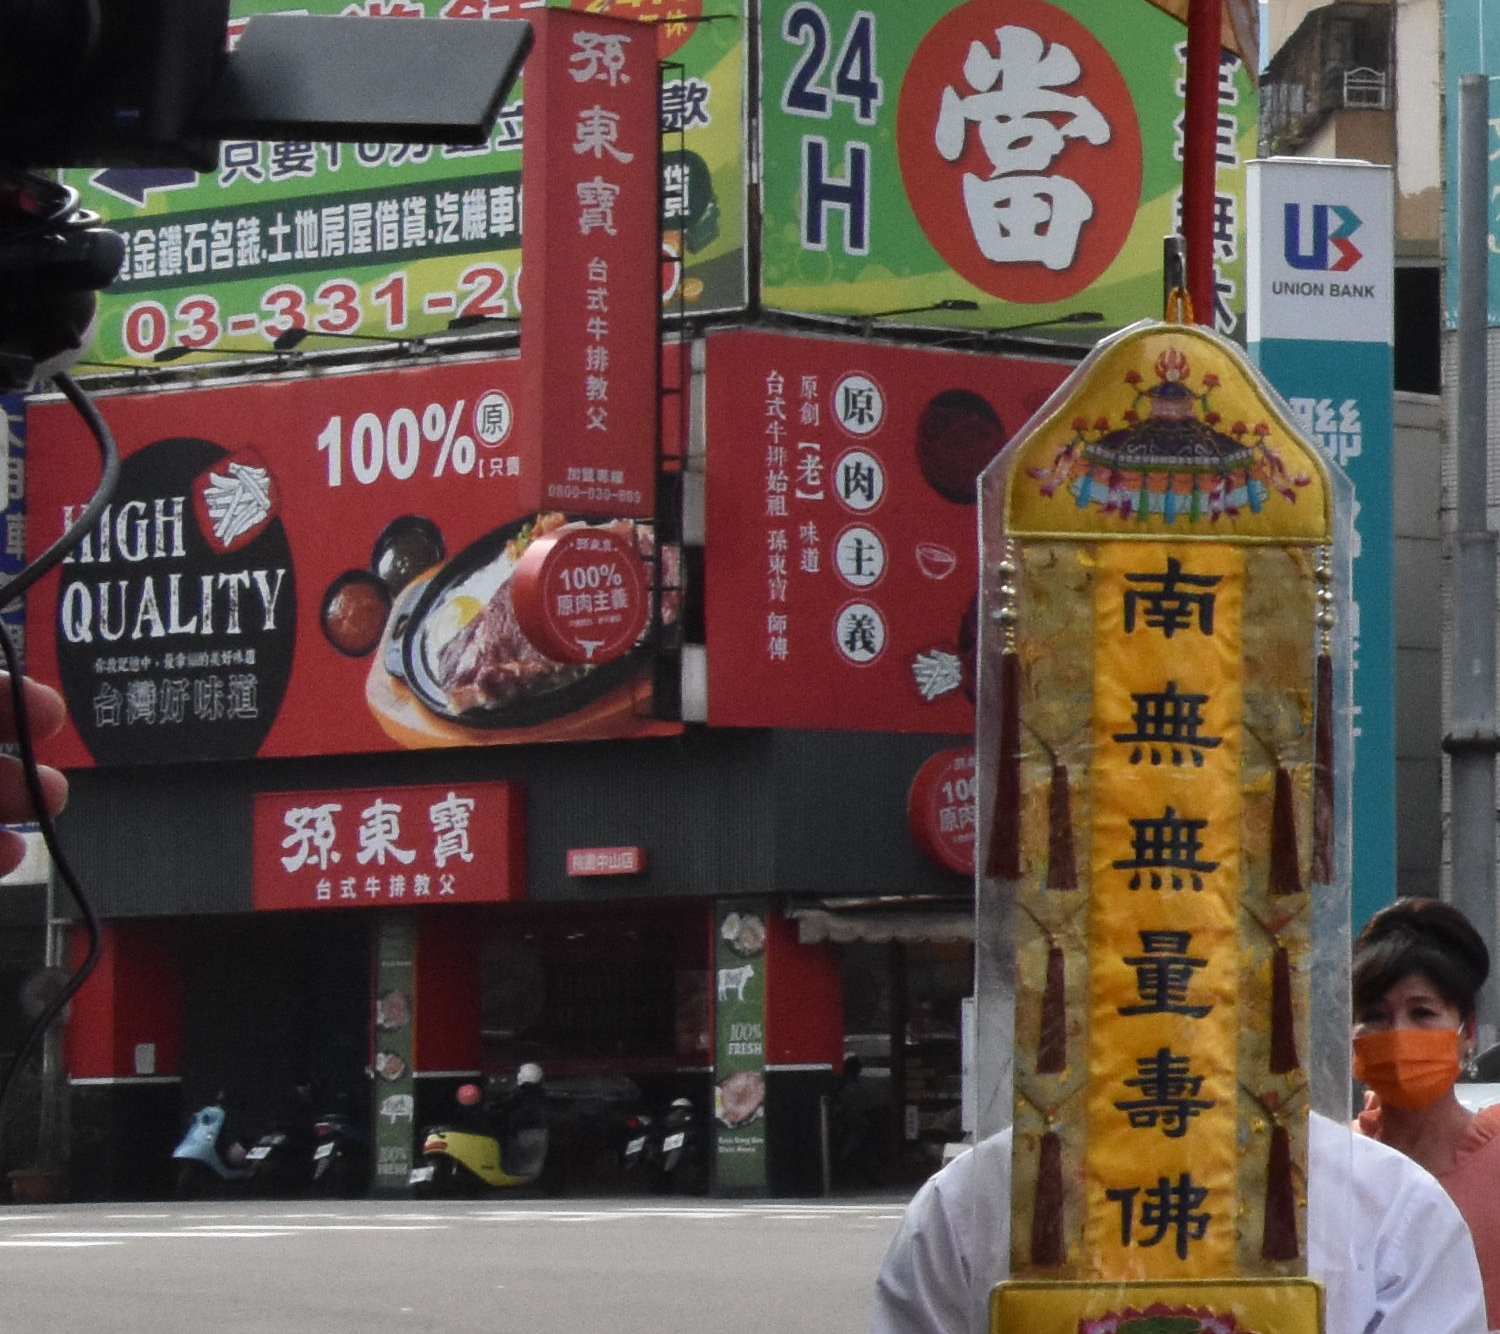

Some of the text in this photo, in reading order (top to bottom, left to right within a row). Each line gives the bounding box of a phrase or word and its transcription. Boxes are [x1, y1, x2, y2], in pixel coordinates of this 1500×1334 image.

[568, 29, 635, 237] 孫東寶
[933, 24, 1112, 271] 當
[800, 133, 873, 257] H
[122, 261, 524, 358] 03-331-2
[1271, 280, 1376, 301] UNION BANK
[585, 255, 609, 432] 台式牛排教父
[316, 399, 477, 487] 100%
[62, 496, 186, 564] HIGH
[841, 384, 877, 656] 原肉主義
[61, 569, 286, 644] QUALITY
[560, 562, 623, 591] 100%
[93, 673, 259, 728] 台灣好味道
[281, 792, 477, 873] 孫東寶
[315, 873, 458, 901] 台式牛排教父
[1104, 555, 1222, 1263] 南無無量壽佛
